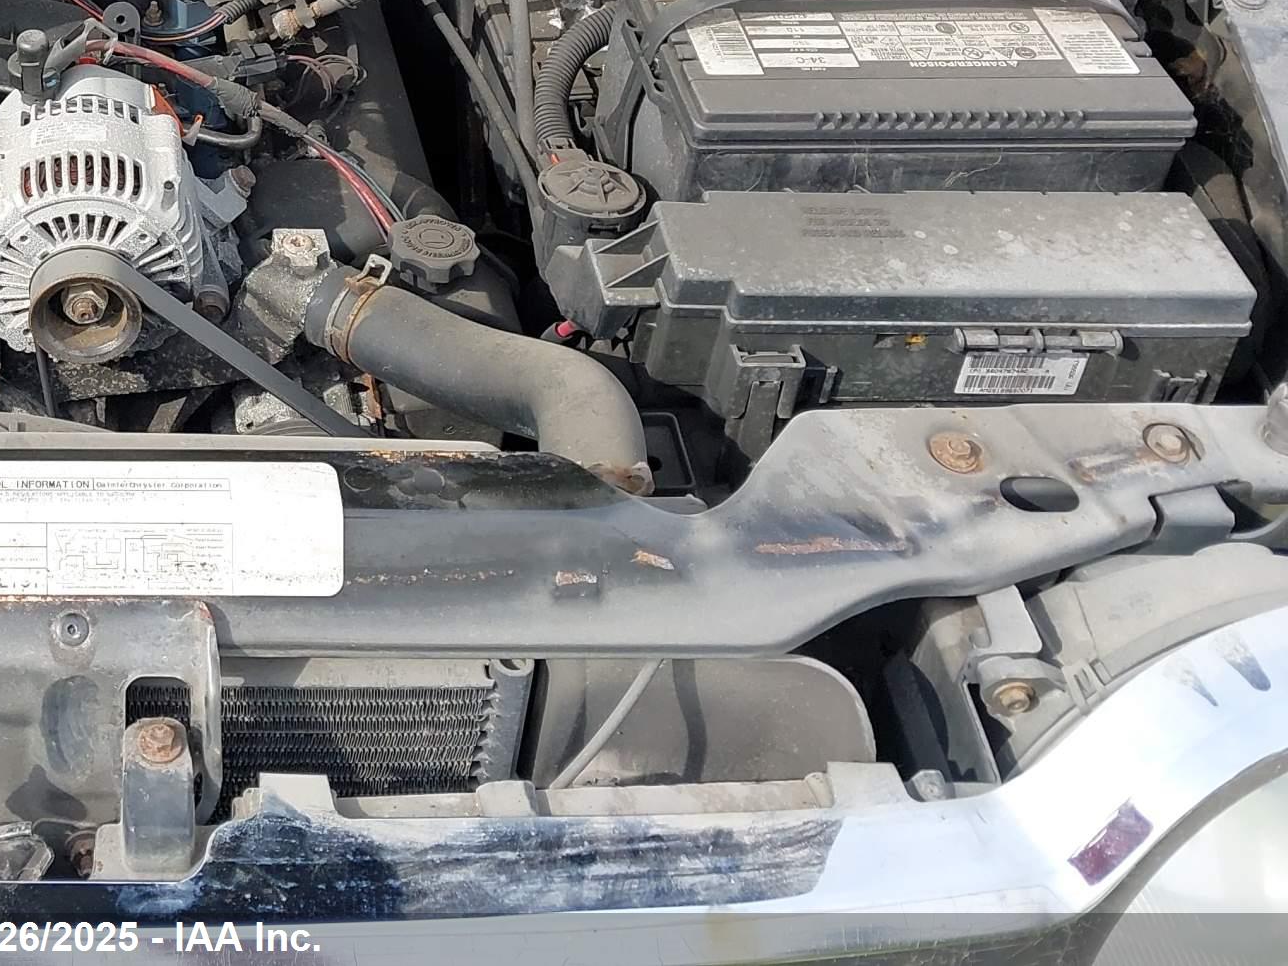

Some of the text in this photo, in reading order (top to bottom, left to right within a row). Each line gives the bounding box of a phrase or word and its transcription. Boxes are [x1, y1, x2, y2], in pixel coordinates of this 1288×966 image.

[909, 60, 1008, 68] DANGER/POISON
[16, 480, 90, 489] INFORMATION
[171, 481, 223, 489] Corporation
